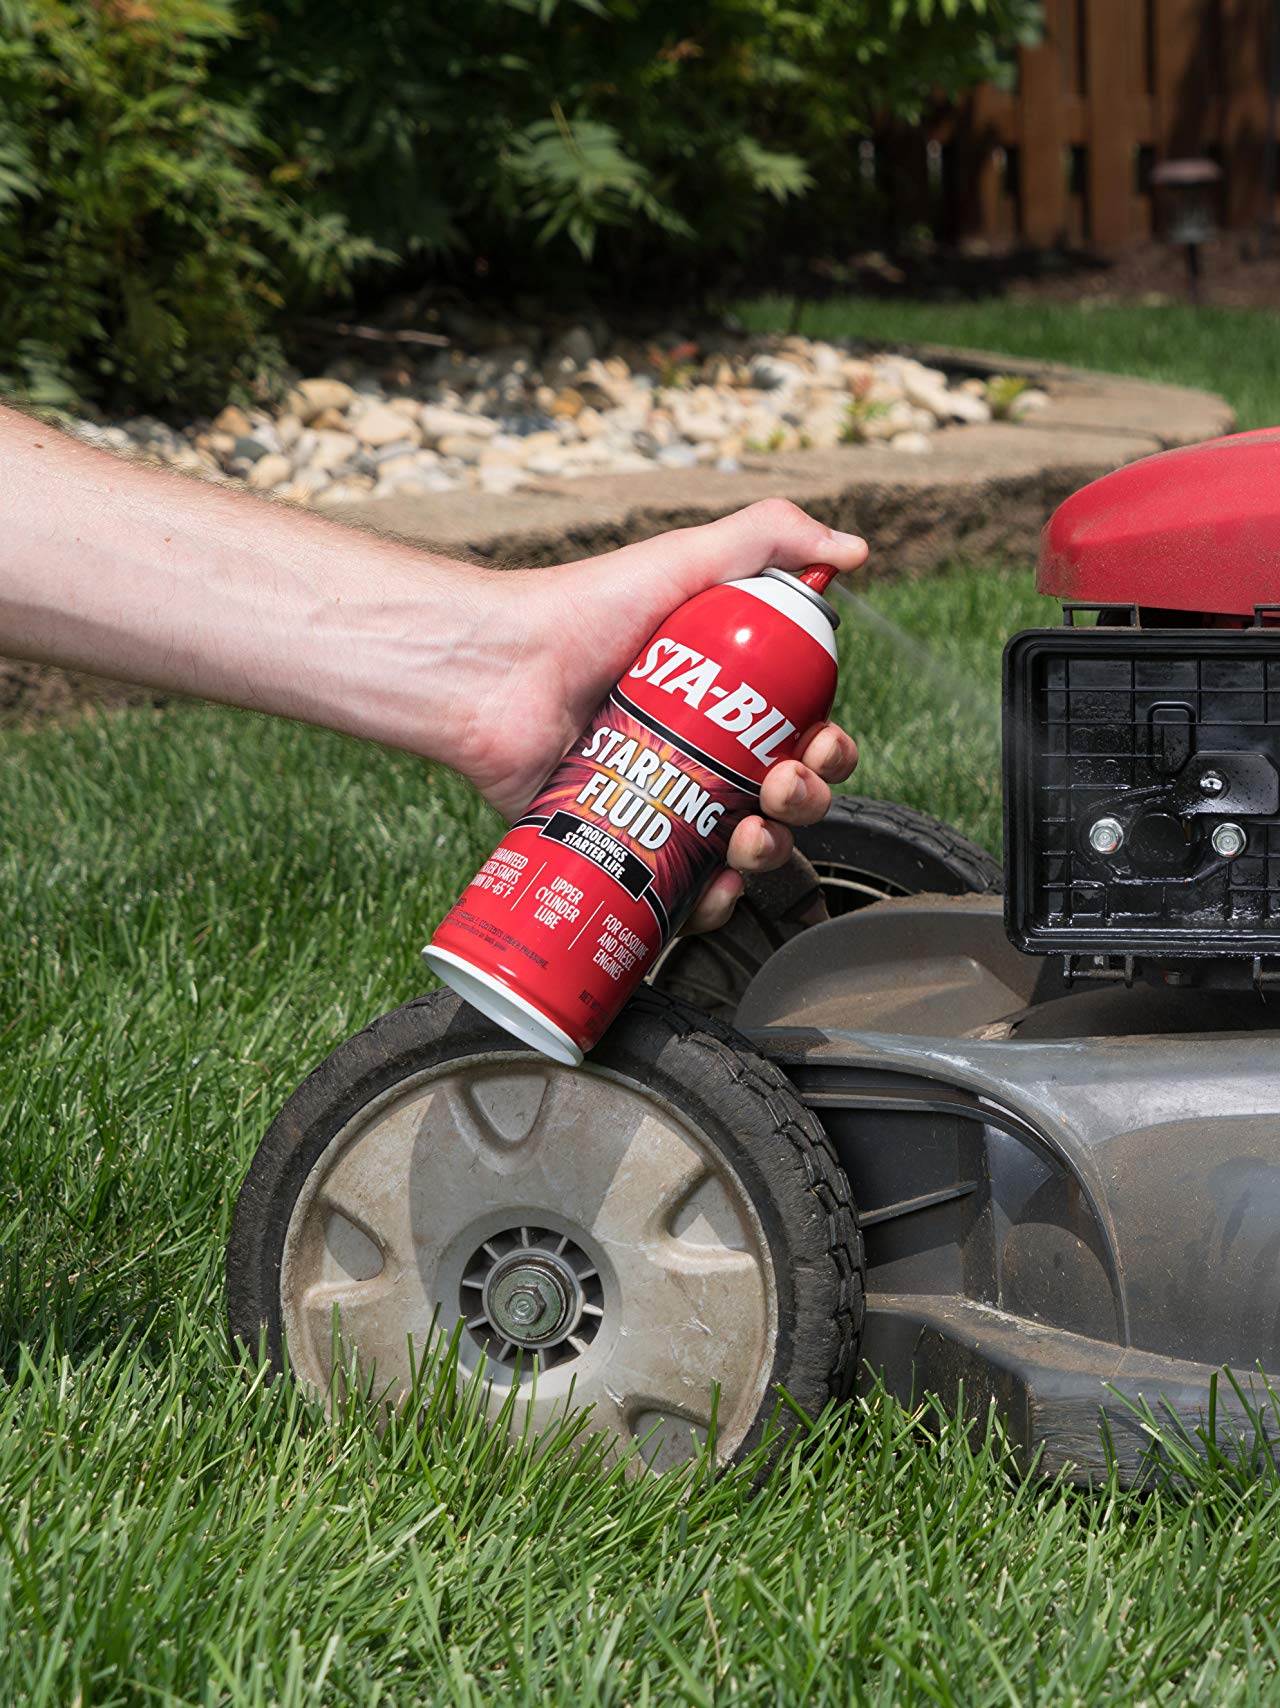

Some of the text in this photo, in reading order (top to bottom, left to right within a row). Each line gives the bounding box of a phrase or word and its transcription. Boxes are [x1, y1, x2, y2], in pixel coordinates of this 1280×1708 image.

[629, 638, 796, 768] STA-BIL
[581, 726, 726, 838] STARTING
[576, 772, 672, 850] FLUID
[562, 831, 626, 880] STARTER LIFE
[576, 822, 628, 863] PROLONGS
[482, 876, 495, 890] TO
[492, 881, 514, 899] -65°F
[494, 864, 522, 885] STARTS
[550, 876, 584, 906] UPPER
[534, 905, 562, 930] LUBE
[535, 886, 580, 924] CYLINDER
[596, 932, 636, 971] AND DIESEL
[602, 914, 648, 960] FOR GASOLINE
[592, 948, 624, 981] ENGINES
